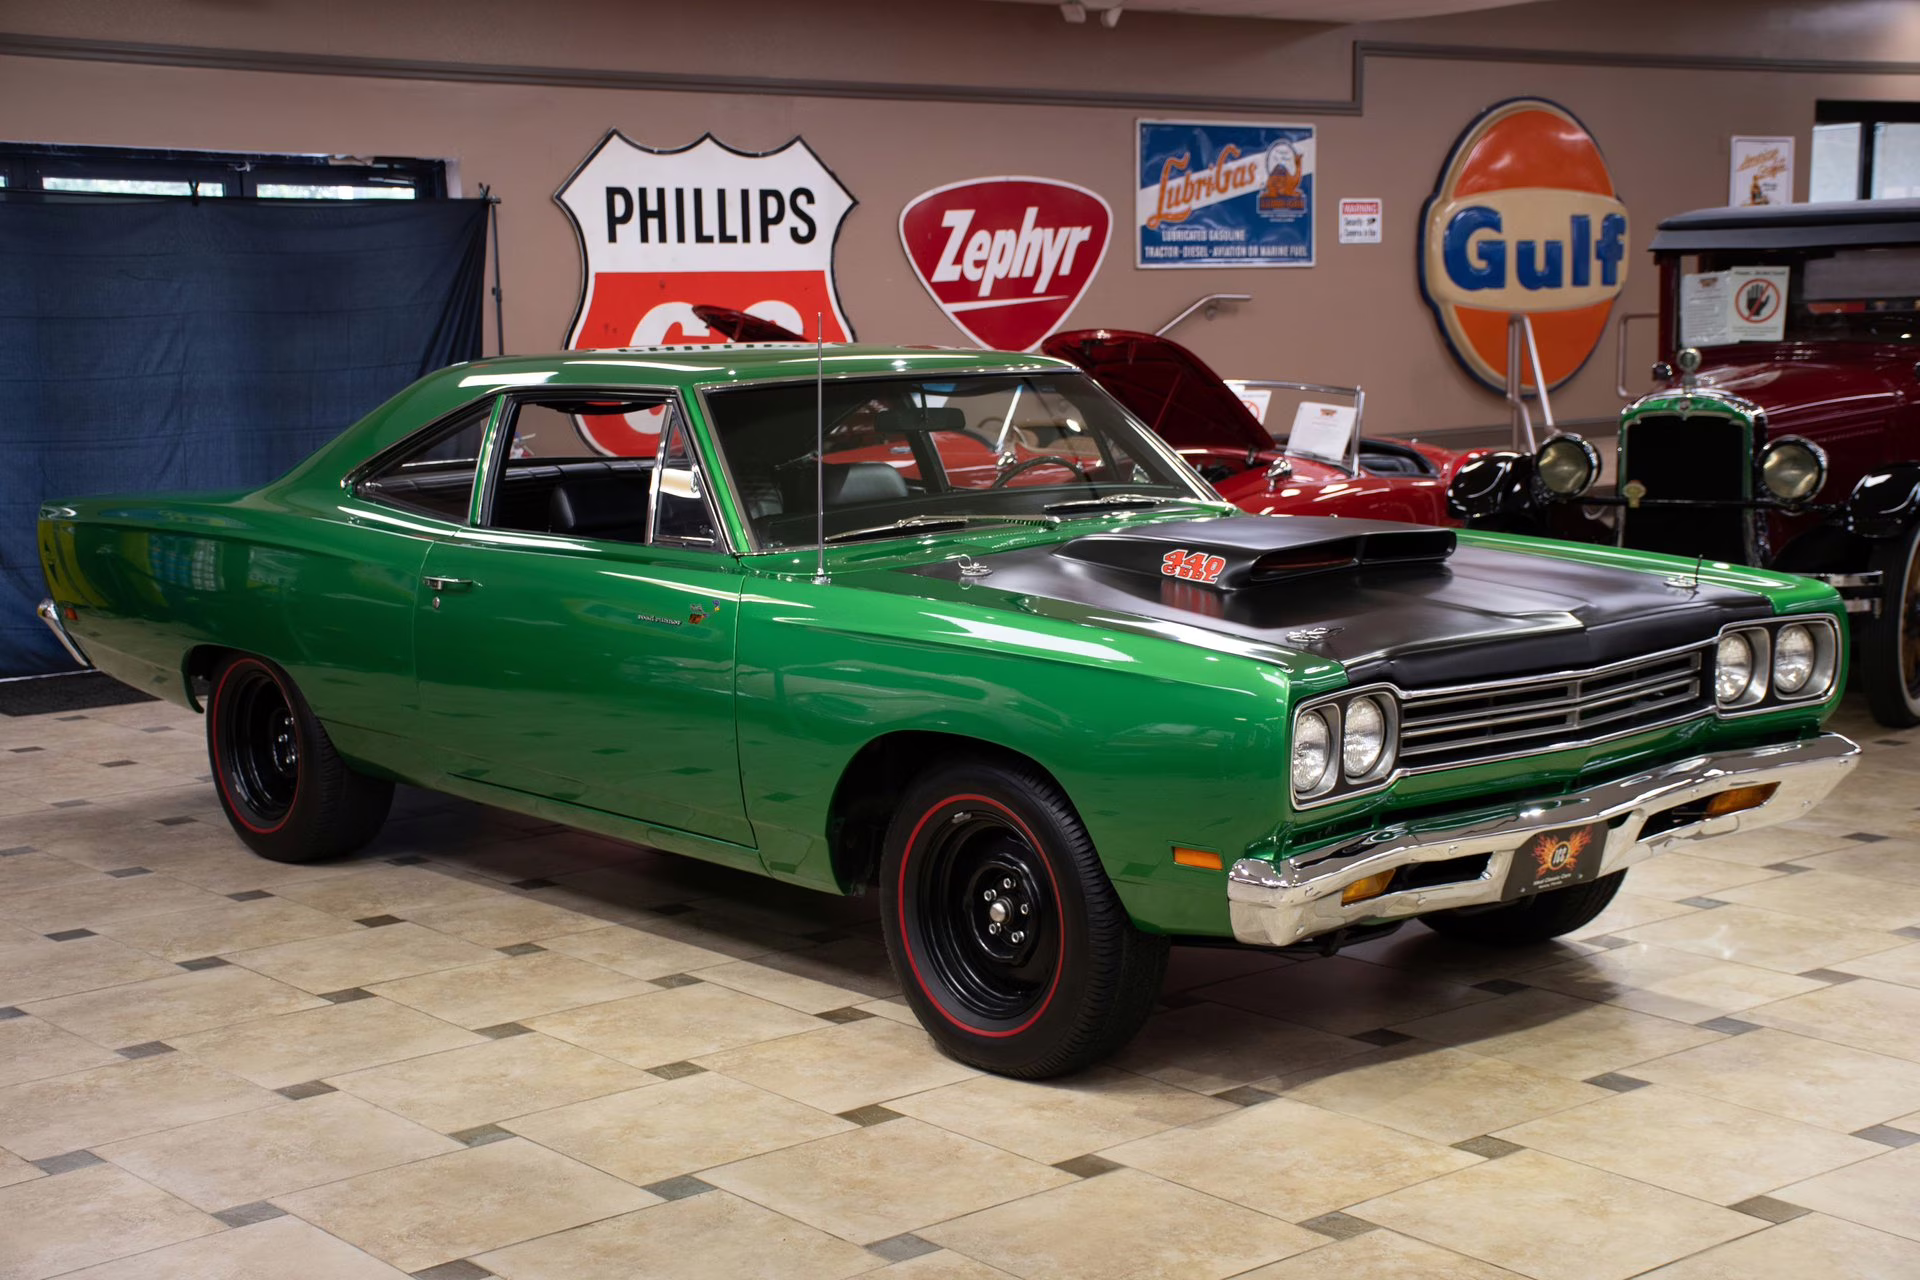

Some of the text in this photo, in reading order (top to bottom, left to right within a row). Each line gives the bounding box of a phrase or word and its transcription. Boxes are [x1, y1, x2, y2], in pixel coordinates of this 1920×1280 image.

[605, 186, 817, 245] PHILLIPS
[1162, 229, 1246, 241] LUBRICATED GASOLINE
[930, 206, 1092, 297] Zephyr
[1247, 245, 1258, 257] OR
[1259, 245, 1289, 257] MARINE
[1289, 245, 1308, 257] FUEL
[1443, 205, 1627, 292] Gulf
[1162, 549, 1227, 574] 440
